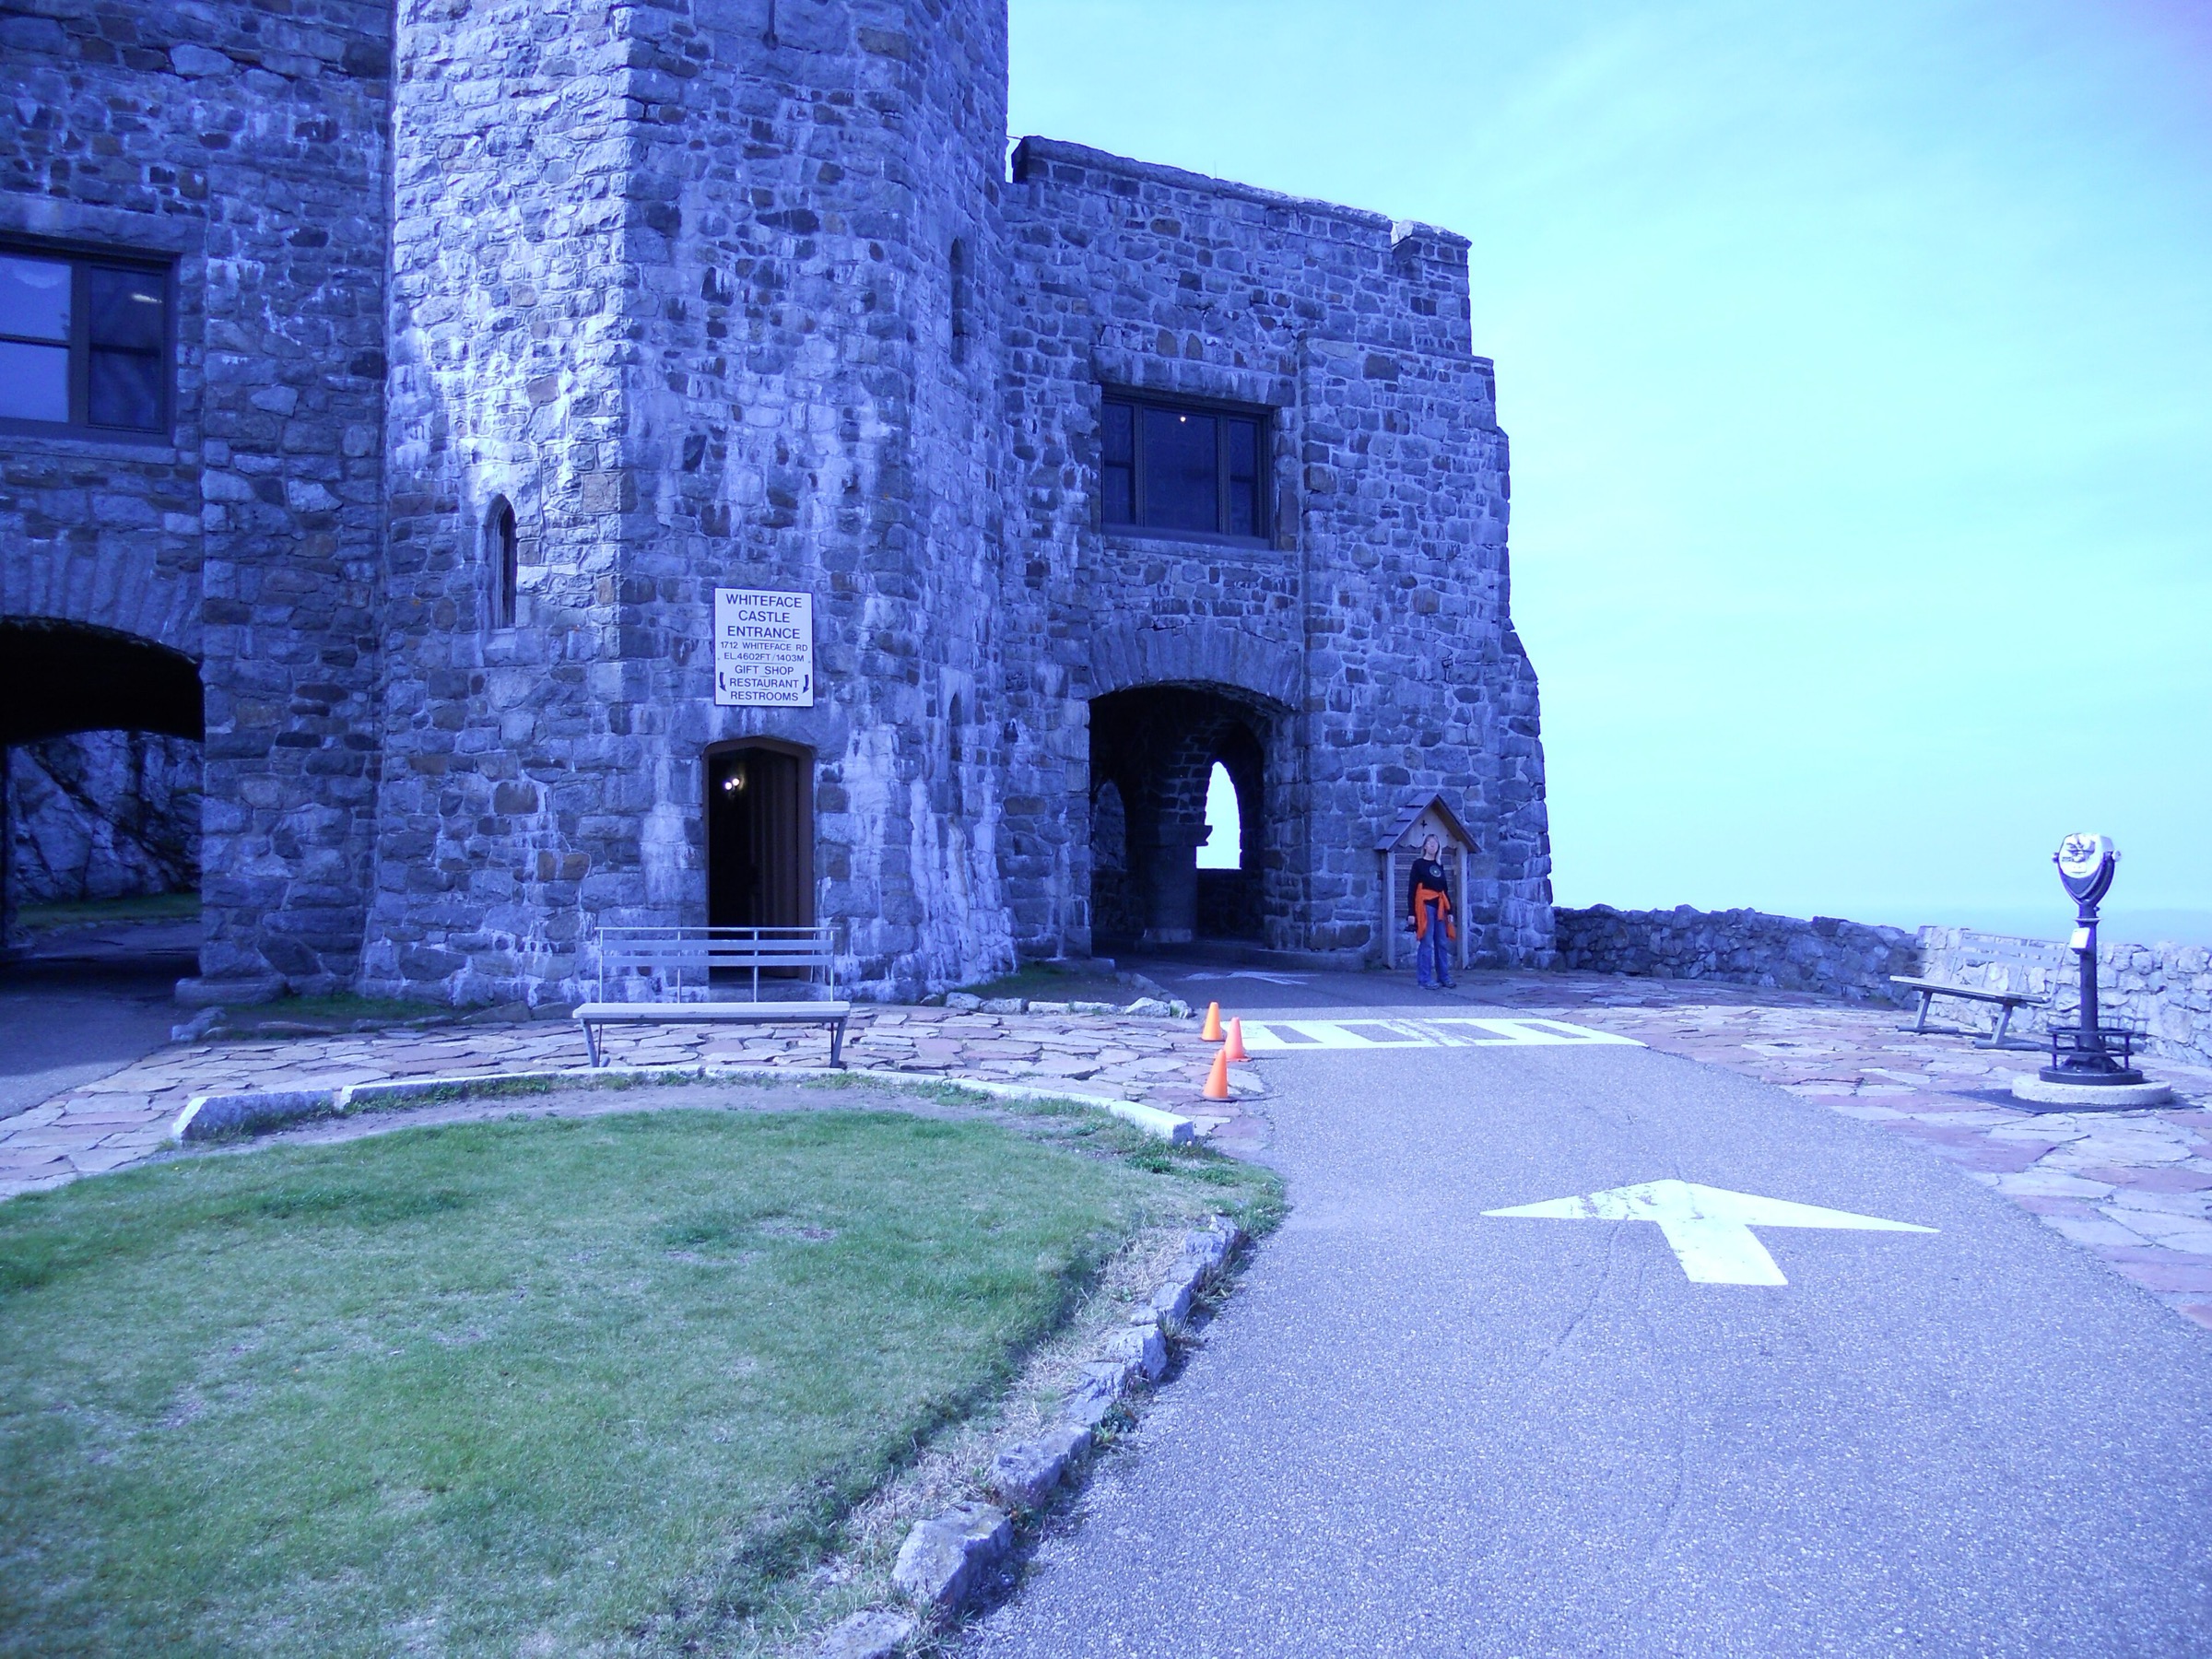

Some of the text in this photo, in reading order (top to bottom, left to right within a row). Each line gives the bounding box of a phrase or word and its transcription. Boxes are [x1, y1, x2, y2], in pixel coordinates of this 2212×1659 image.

[726, 594, 802, 608] WHITEFACE
[738, 610, 790, 623] CASTLE
[727, 626, 800, 639] ENTRANCE
[742, 642, 792, 651] WHITEFACE
[735, 665, 794, 675] GIFT SHOP
[729, 677, 799, 688] RESTAURANT
[730, 691, 799, 700] RESTROOMS
